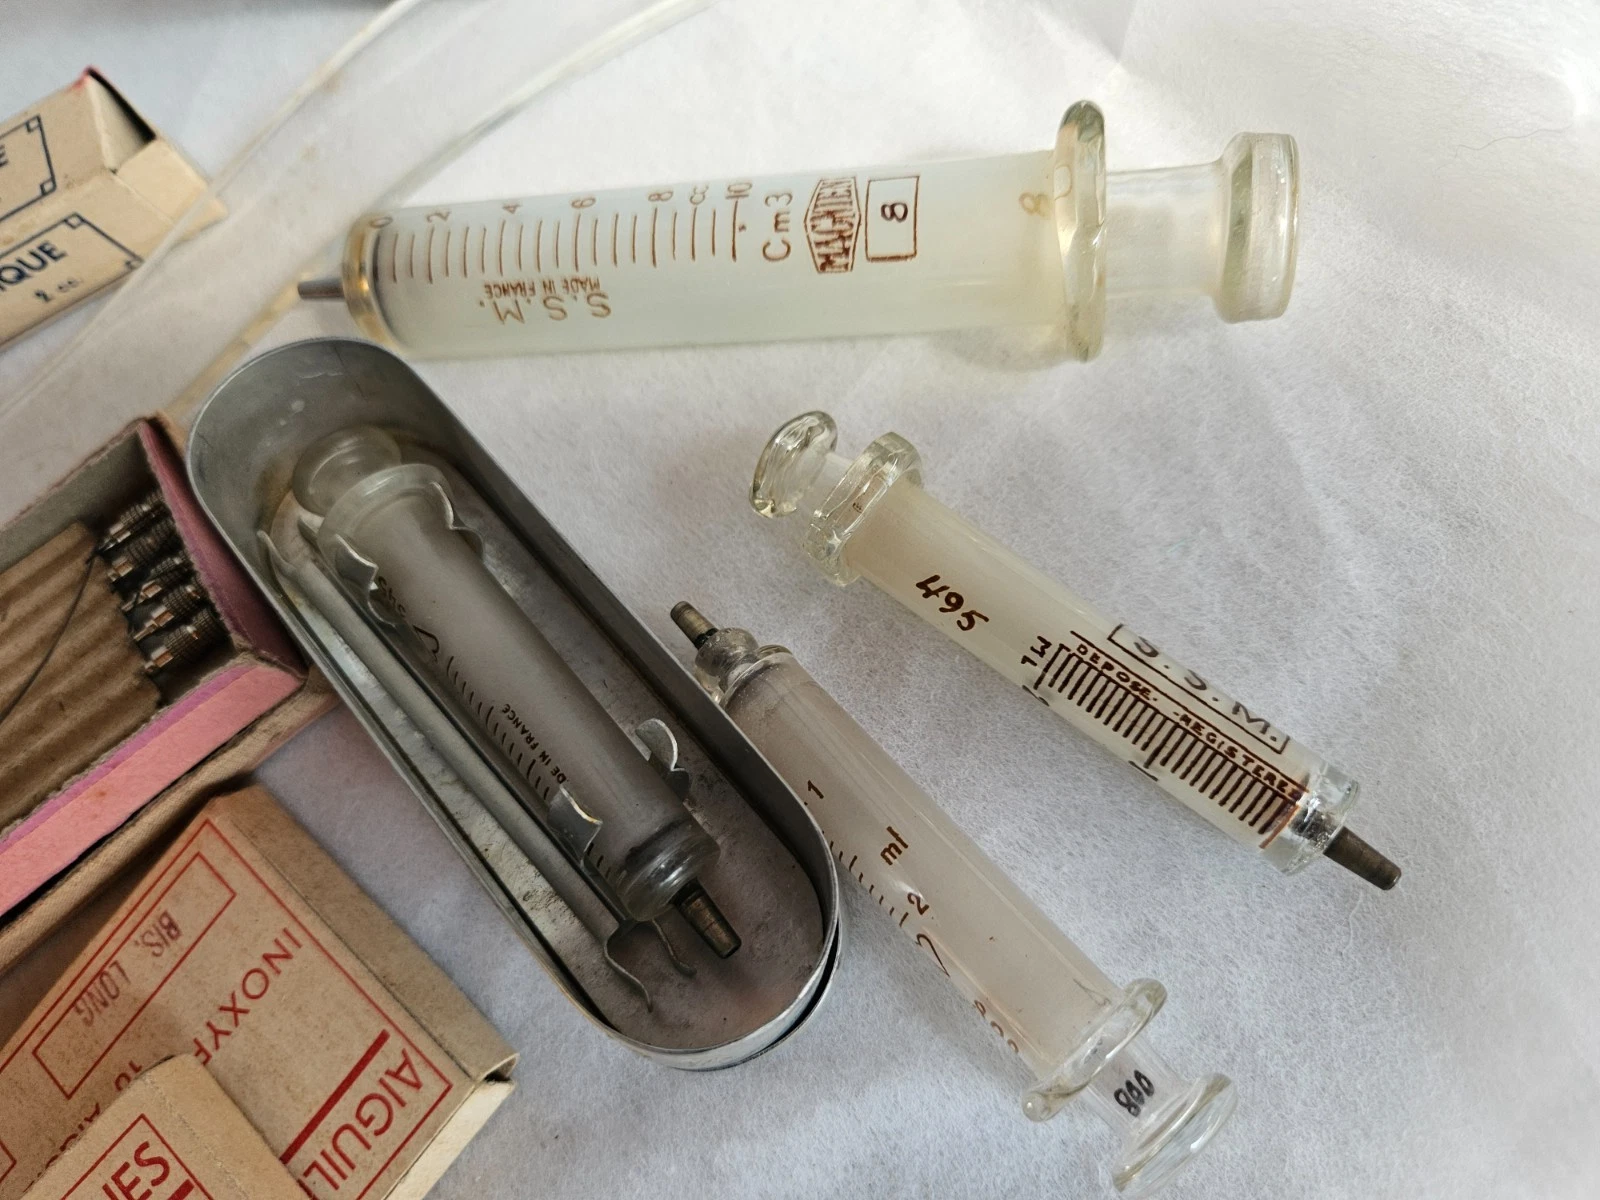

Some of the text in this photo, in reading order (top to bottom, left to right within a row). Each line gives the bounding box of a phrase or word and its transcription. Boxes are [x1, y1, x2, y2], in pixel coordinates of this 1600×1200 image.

[880, 202, 909, 222] 8
[484, 277, 600, 296] MADE IN FRANCE
[916, 575, 989, 631] 495
[501, 702, 539, 750] FRANCE
[807, 780, 825, 799] 1
[880, 826, 909, 865] ml
[907, 892, 930, 916] 2
[74, 960, 131, 1026] LONG
